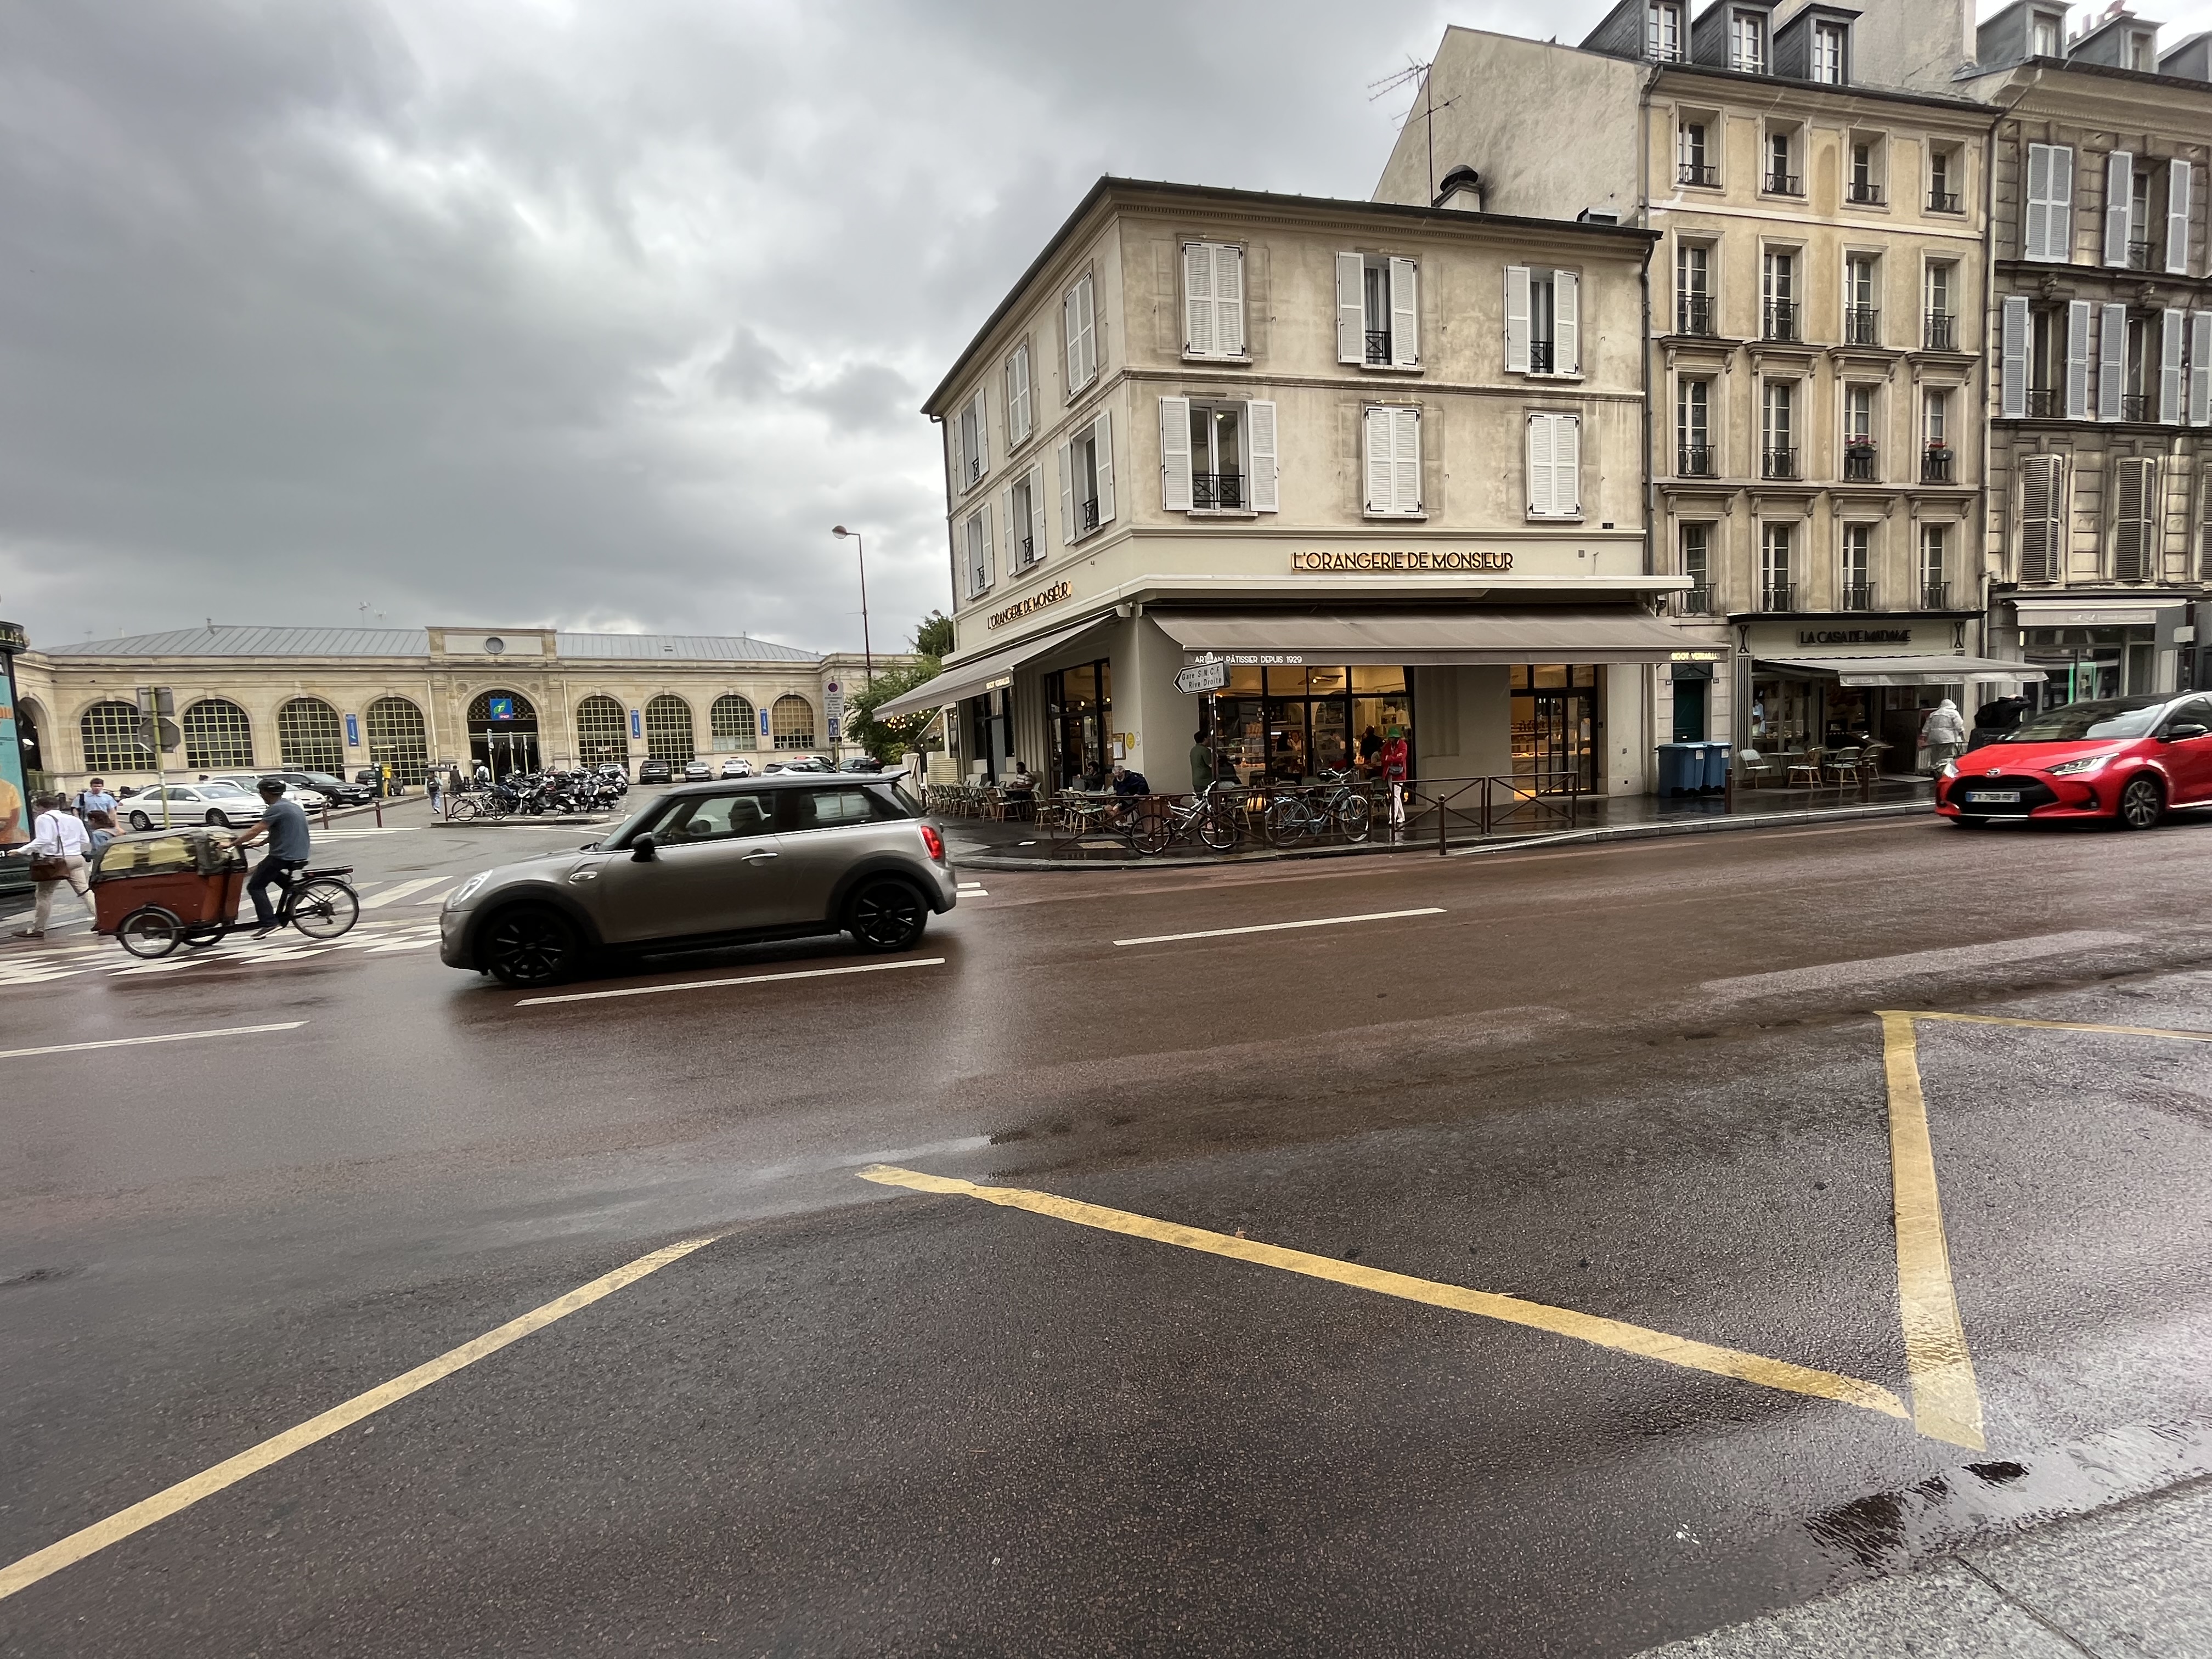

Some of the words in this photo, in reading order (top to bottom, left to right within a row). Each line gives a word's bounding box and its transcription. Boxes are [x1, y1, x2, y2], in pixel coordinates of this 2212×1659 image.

[1293, 552, 1403, 569] L'ORANGERIE
[1408, 552, 1428, 568] DE
[1432, 552, 1514, 568] MONSIEUR
[987, 601, 1023, 630] L'ORANGERIE
[1024, 597, 1032, 613] DE
[1033, 582, 1068, 610] MONSIEUR
[1801, 631, 1815, 644] LA
[1817, 631, 1848, 643] CASA
[1849, 630, 1864, 642] DE
[1865, 630, 1912, 642] MADAME
[1226, 654, 1258, 663] PÂTISSIER
[1204, 678, 1222, 686] Droite
